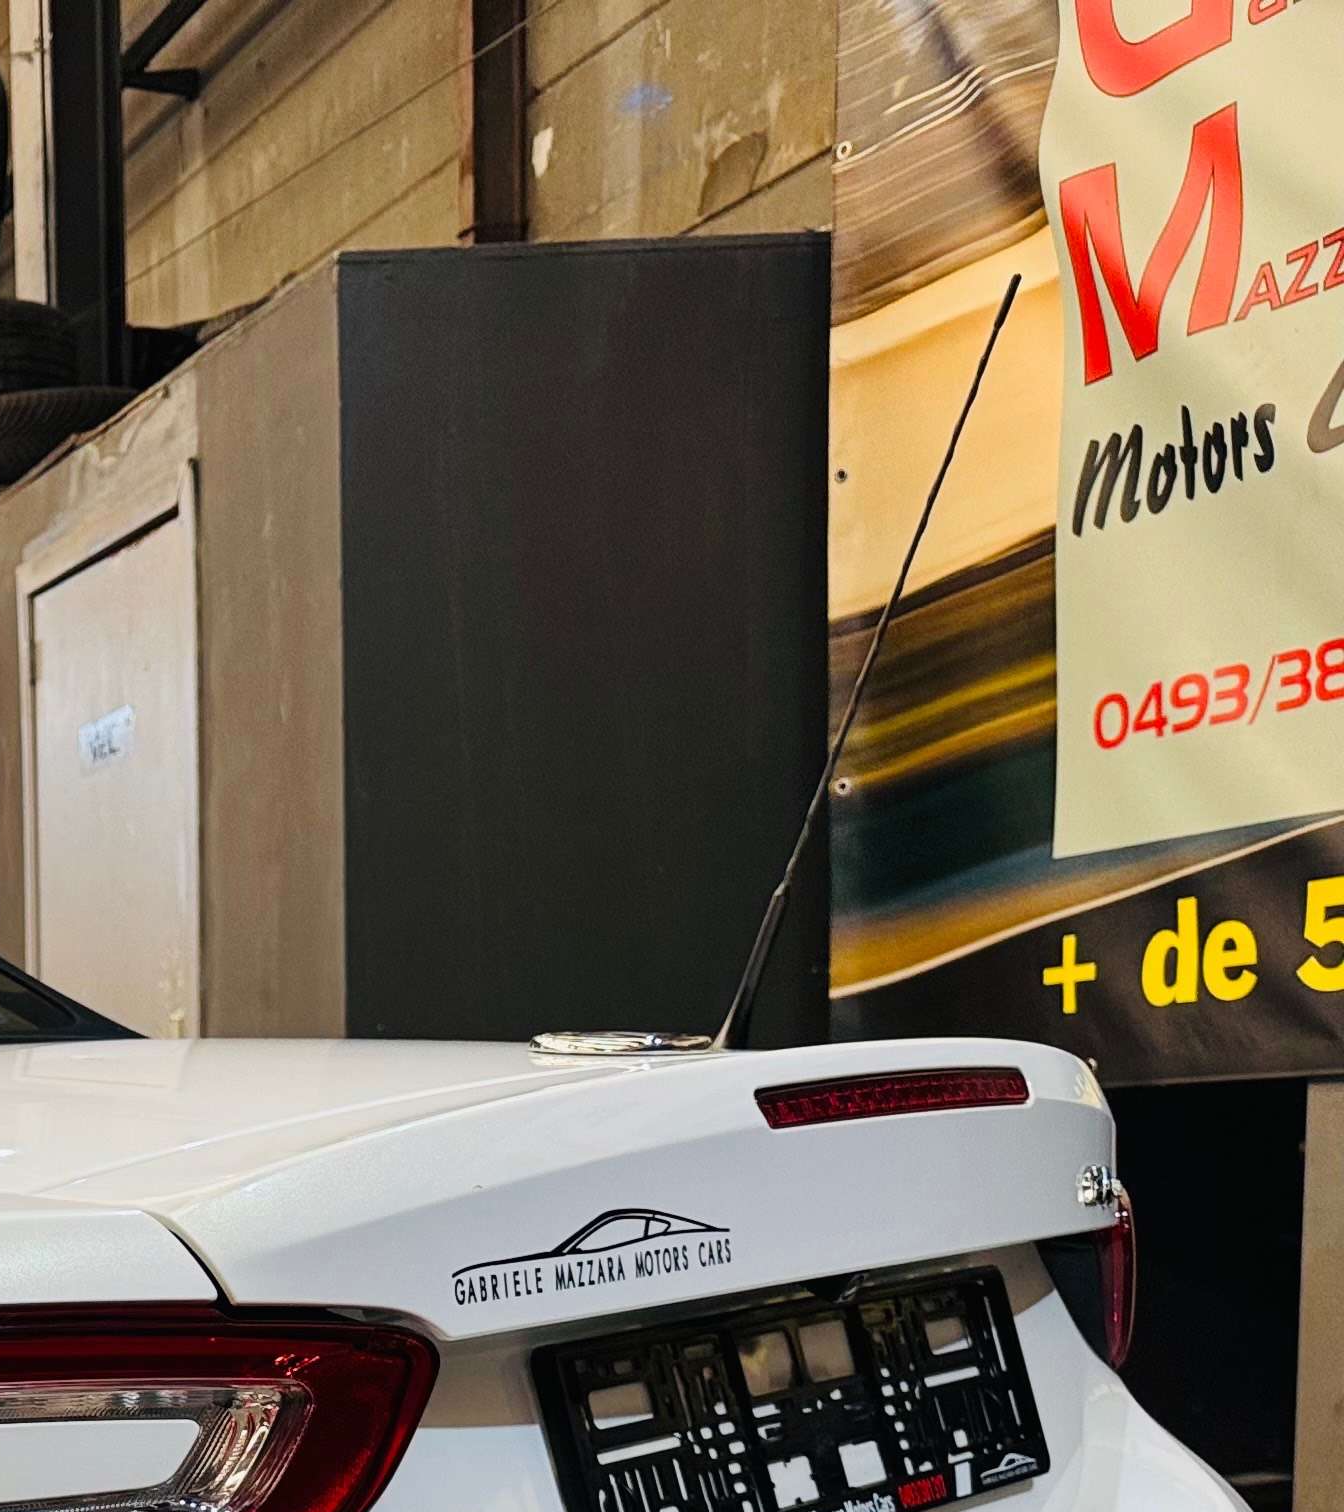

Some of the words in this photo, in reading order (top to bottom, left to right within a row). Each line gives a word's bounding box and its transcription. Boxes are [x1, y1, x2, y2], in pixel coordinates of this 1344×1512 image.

[1072, 404, 1275, 536] Motors
[1093, 637, 1344, 750] 0493/38
[1142, 896, 1258, 1007] de
[454, 1266, 543, 1305] GABRIELE
[555, 1256, 625, 1291] MAZZARA
[635, 1245, 689, 1279] MOTORS
[698, 1238, 732, 1267] CARS
